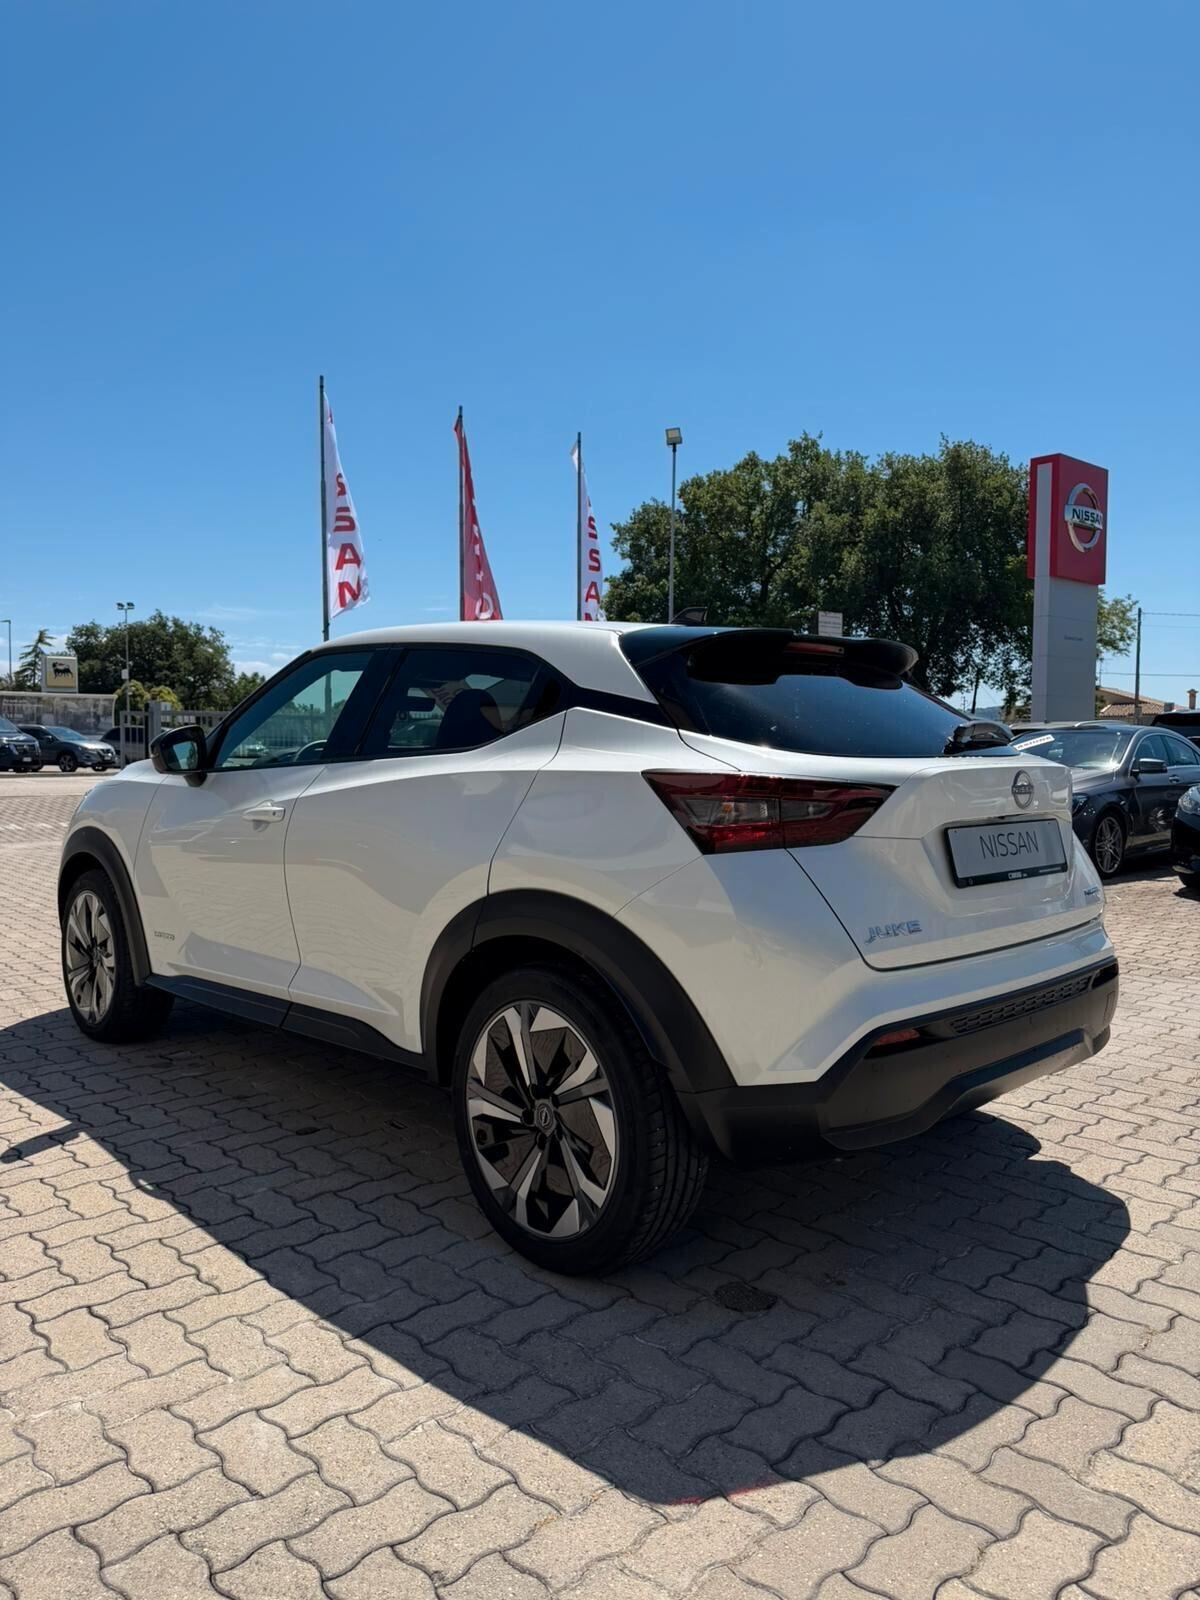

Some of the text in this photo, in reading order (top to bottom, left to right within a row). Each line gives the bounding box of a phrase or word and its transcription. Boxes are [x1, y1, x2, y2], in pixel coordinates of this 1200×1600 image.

[1072, 508, 1102, 525] NISSA
[979, 830, 1039, 859] NISSAN
[864, 920, 922, 944] JUKE
